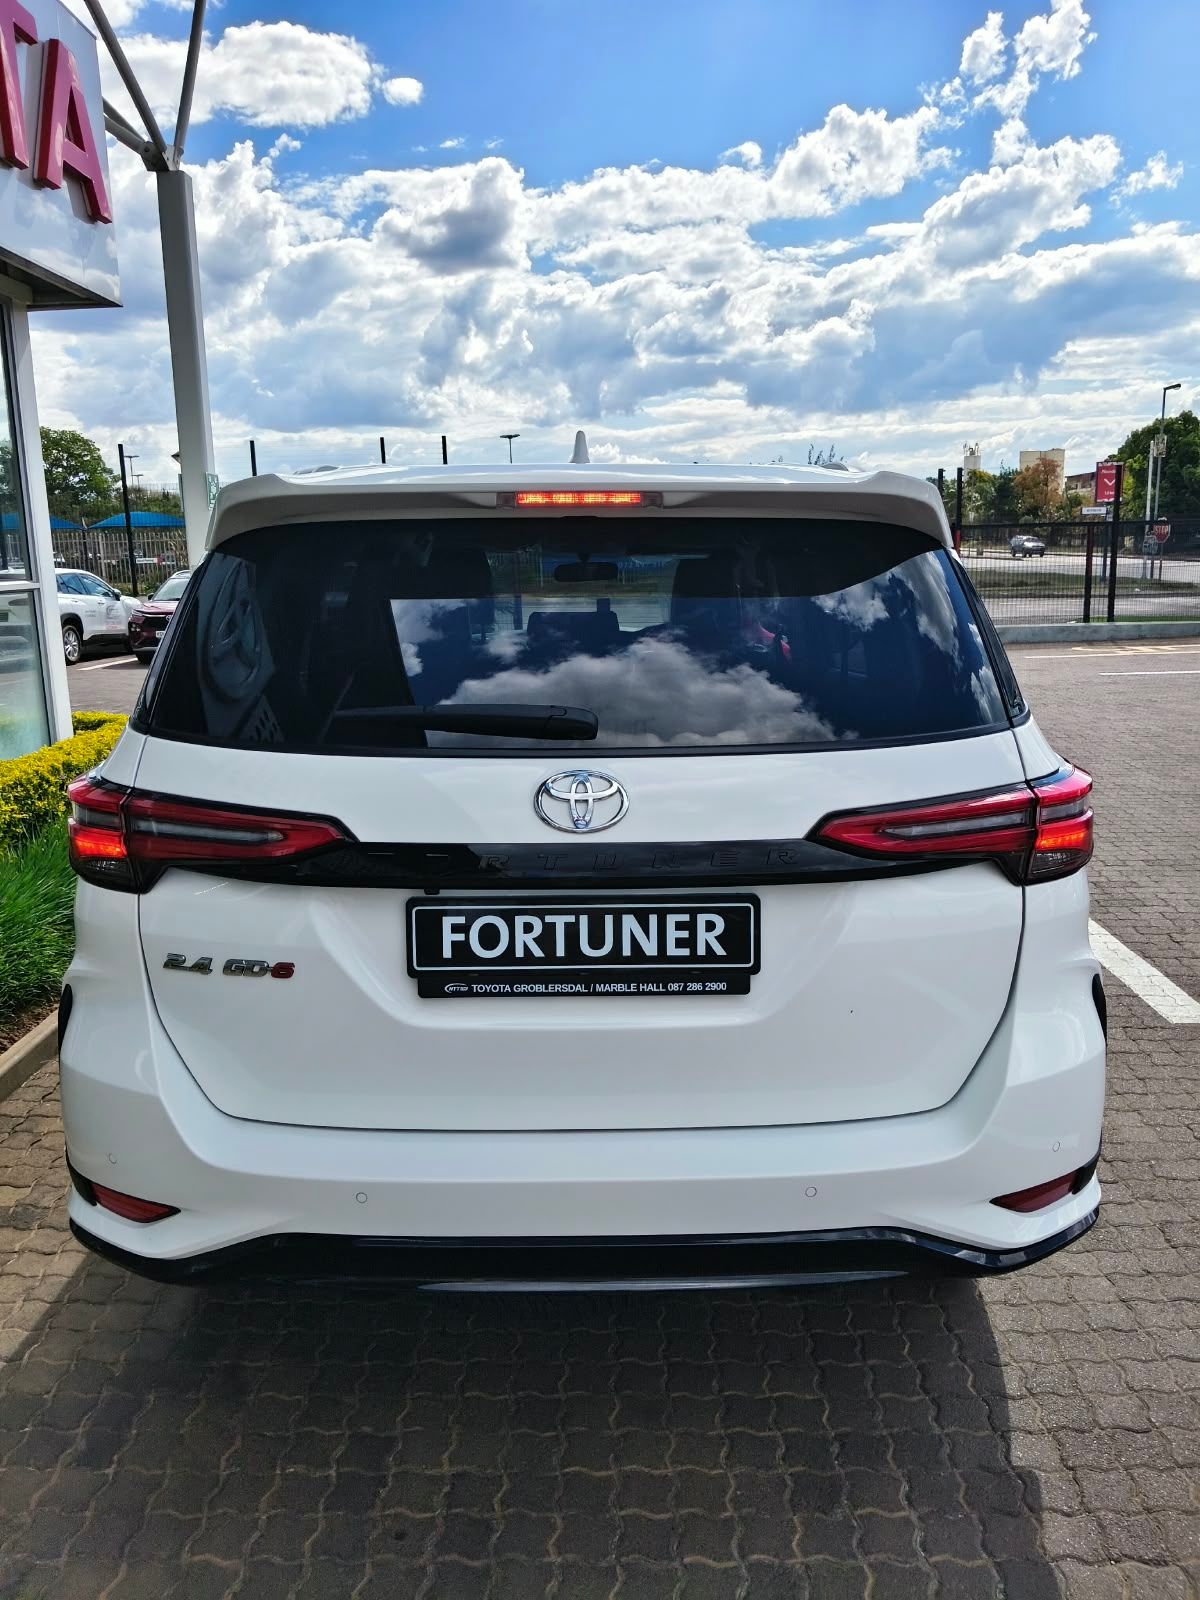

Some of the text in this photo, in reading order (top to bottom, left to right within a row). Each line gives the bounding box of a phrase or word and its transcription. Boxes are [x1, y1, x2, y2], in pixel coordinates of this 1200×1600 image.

[442, 913, 727, 959] FORTUNER
[222, 958, 296, 979] GD-6
[471, 983, 511, 994] TOYOTA
[513, 983, 589, 994] GROBLERSDAL
[595, 983, 637, 993] MARBLE
[639, 982, 666, 993] HALL
[668, 982, 684, 992] 087
[687, 982, 703, 992] 286
[704, 981, 727, 992] 2900
